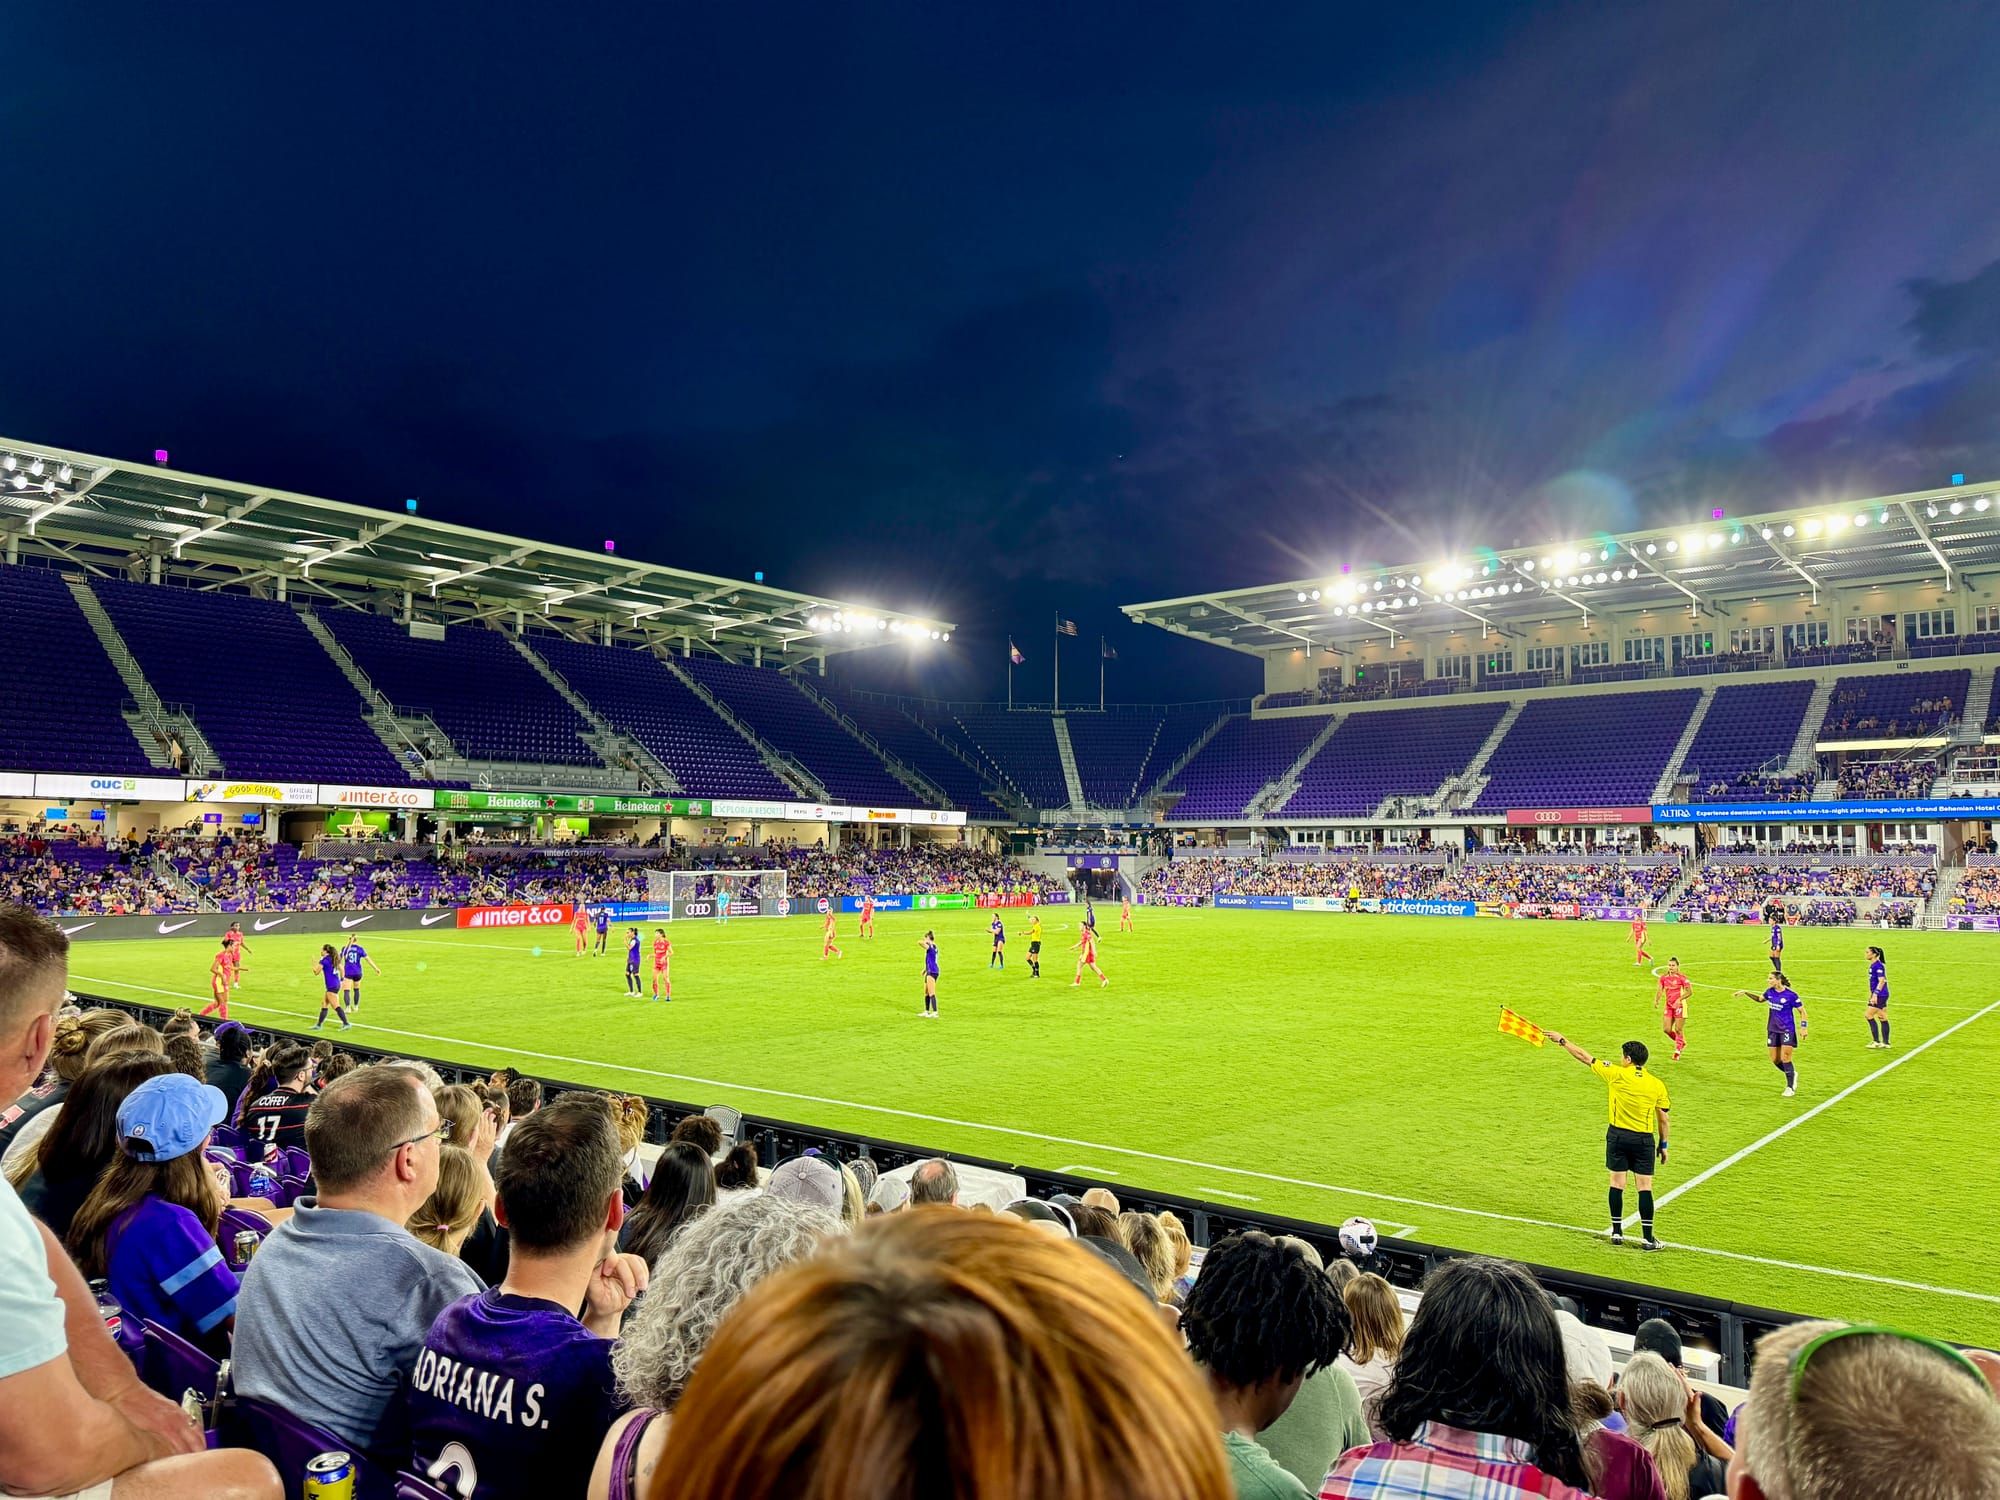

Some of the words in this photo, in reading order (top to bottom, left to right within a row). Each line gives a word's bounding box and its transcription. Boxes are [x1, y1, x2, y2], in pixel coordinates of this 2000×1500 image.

[90, 780, 122, 789] OUC
[229, 785, 252, 795] GOOD
[487, 796, 542, 809] Heineken
[614, 800, 661, 812] Heineken
[1808, 807, 1849, 815] day-to-night
[1891, 806, 1905, 814] only
[1939, 804, 1974, 812] Bohemian
[1975, 804, 1995, 812] Hotel
[1387, 901, 1467, 915] ticketmaster
[348, 951, 358, 964] 31
[258, 1095, 290, 1107] COFFEY
[257, 1115, 282, 1141] 17
[412, 1346, 515, 1425] ADRIANA
[520, 1383, 549, 1430] S.
